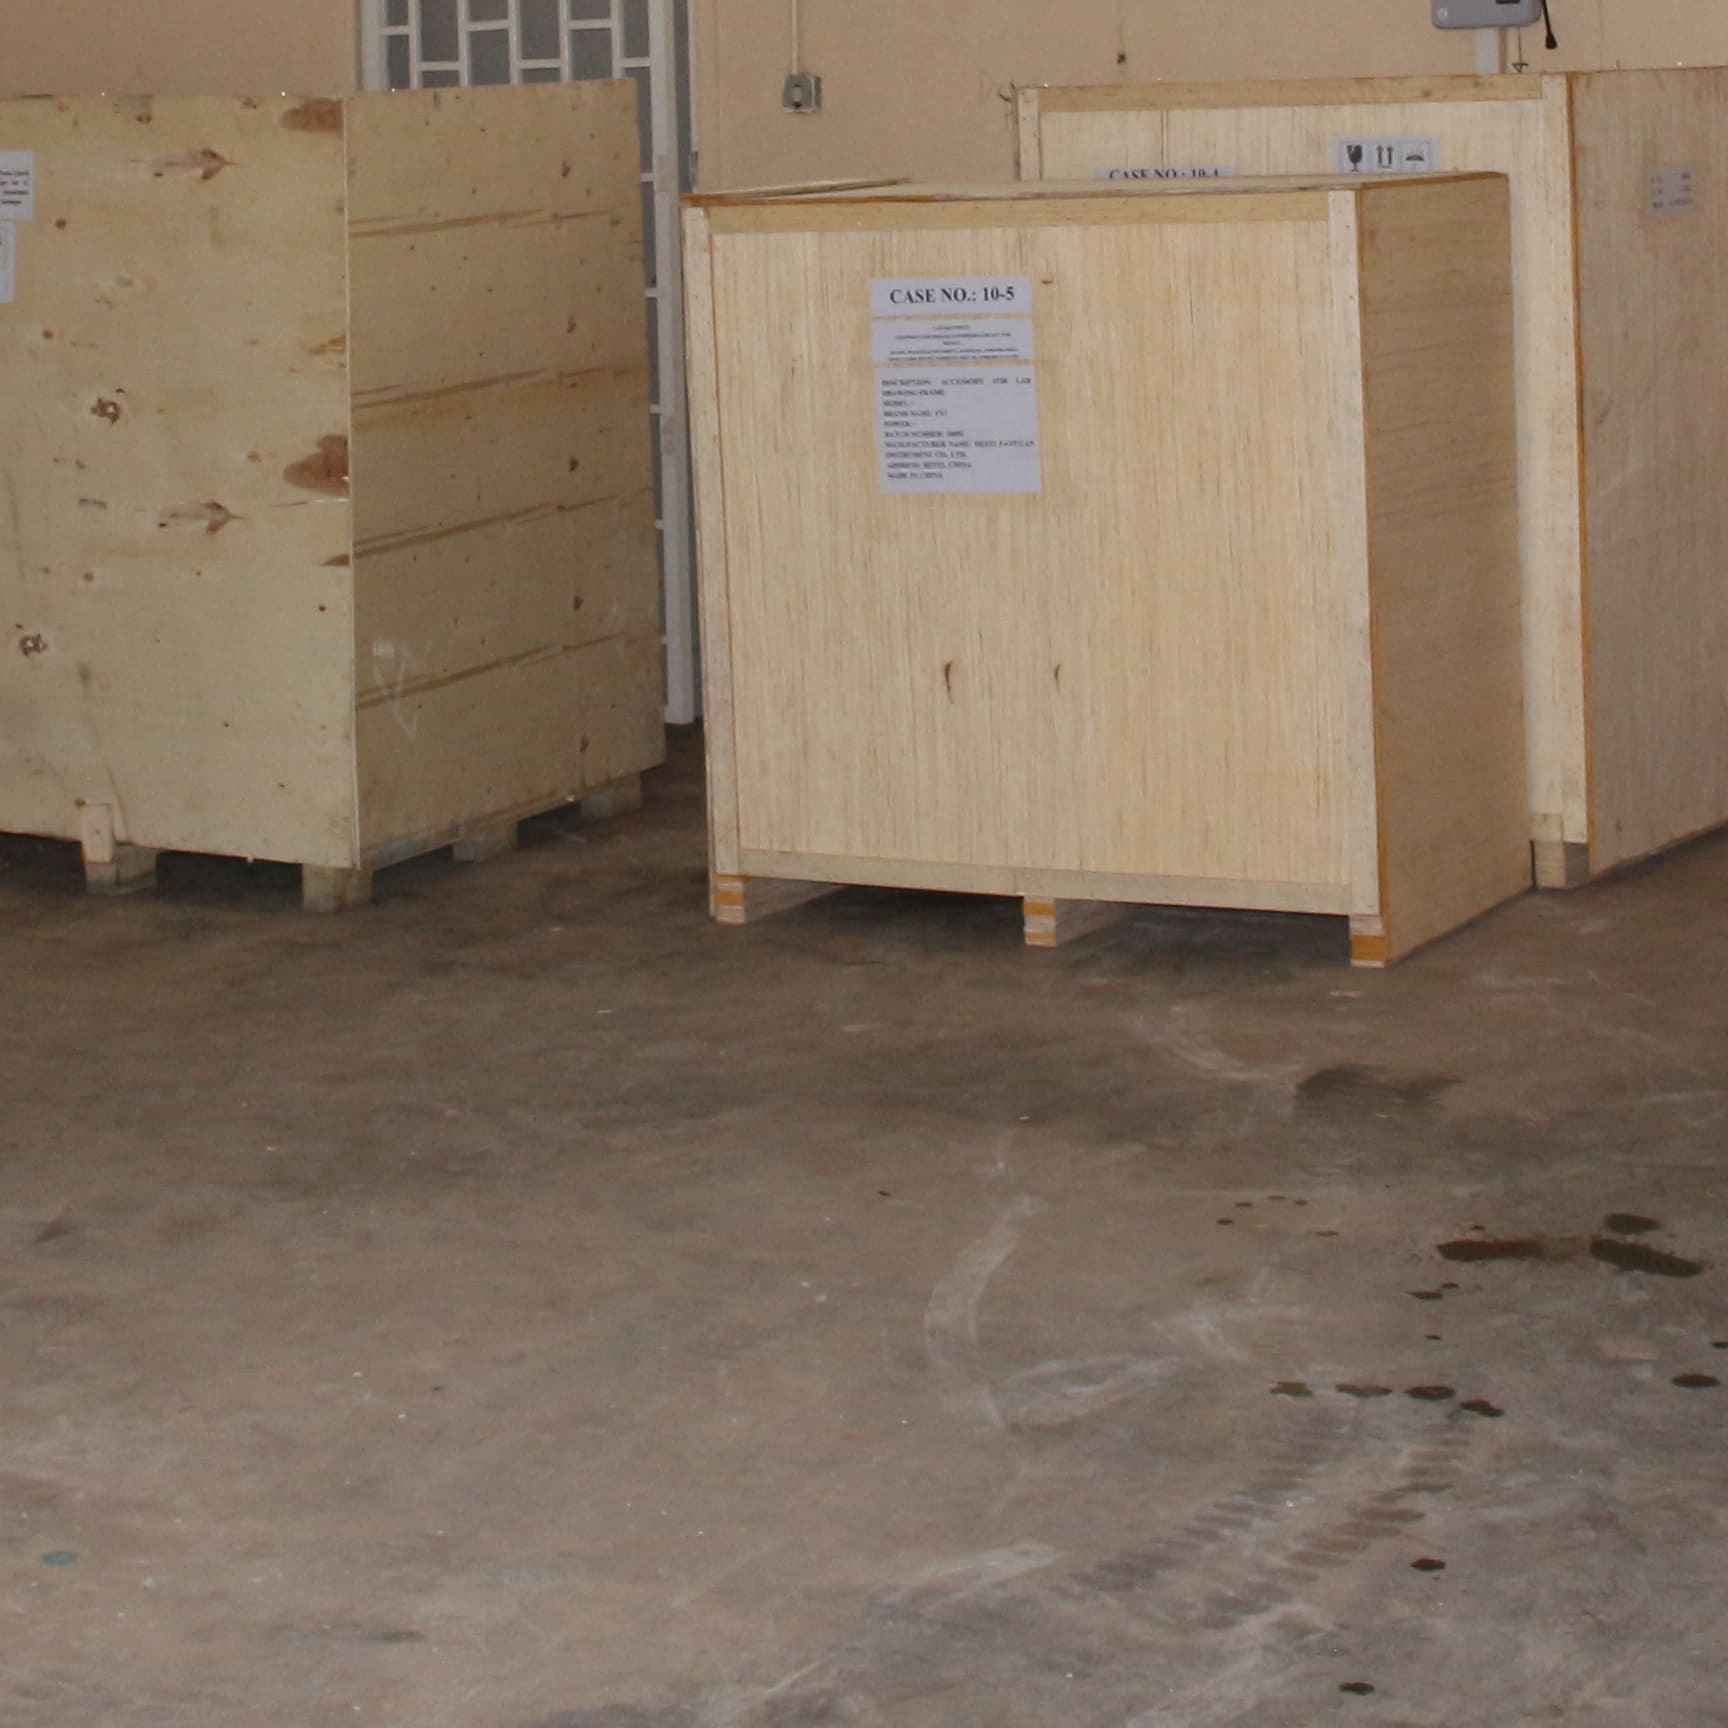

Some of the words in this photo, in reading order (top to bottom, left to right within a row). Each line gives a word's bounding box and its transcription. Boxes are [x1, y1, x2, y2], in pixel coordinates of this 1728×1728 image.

[890, 287, 936, 304] CASE
[941, 287, 977, 303] NO.:
[982, 285, 1015, 302] 10-5
